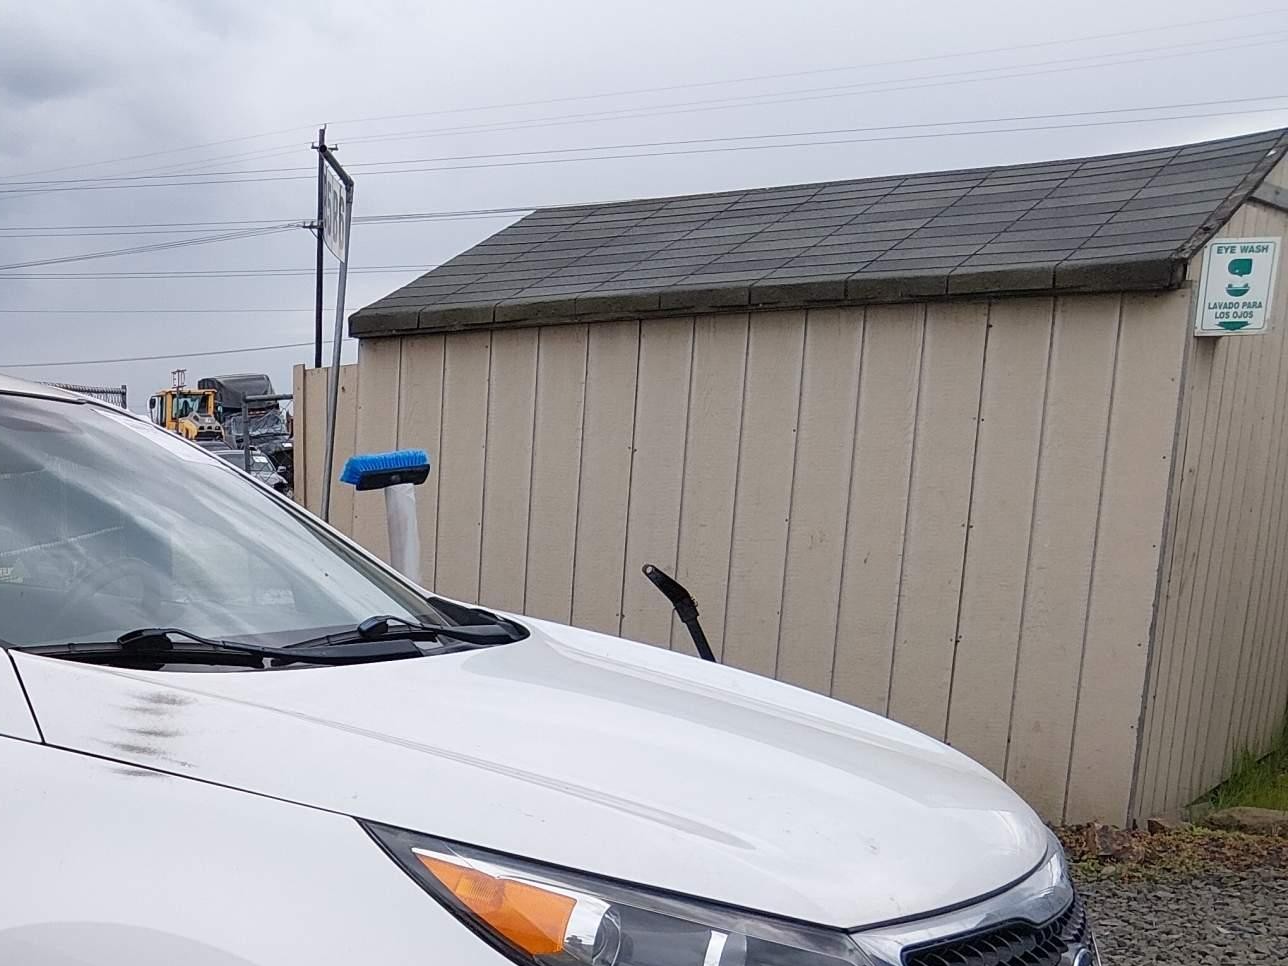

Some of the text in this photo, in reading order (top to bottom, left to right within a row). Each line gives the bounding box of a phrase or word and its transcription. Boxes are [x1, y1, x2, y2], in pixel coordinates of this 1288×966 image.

[1217, 245, 1269, 254] EYE WASH
[1208, 301, 1263, 310] LAVADO PARA
[1214, 311, 1254, 319] LOS OJOS
